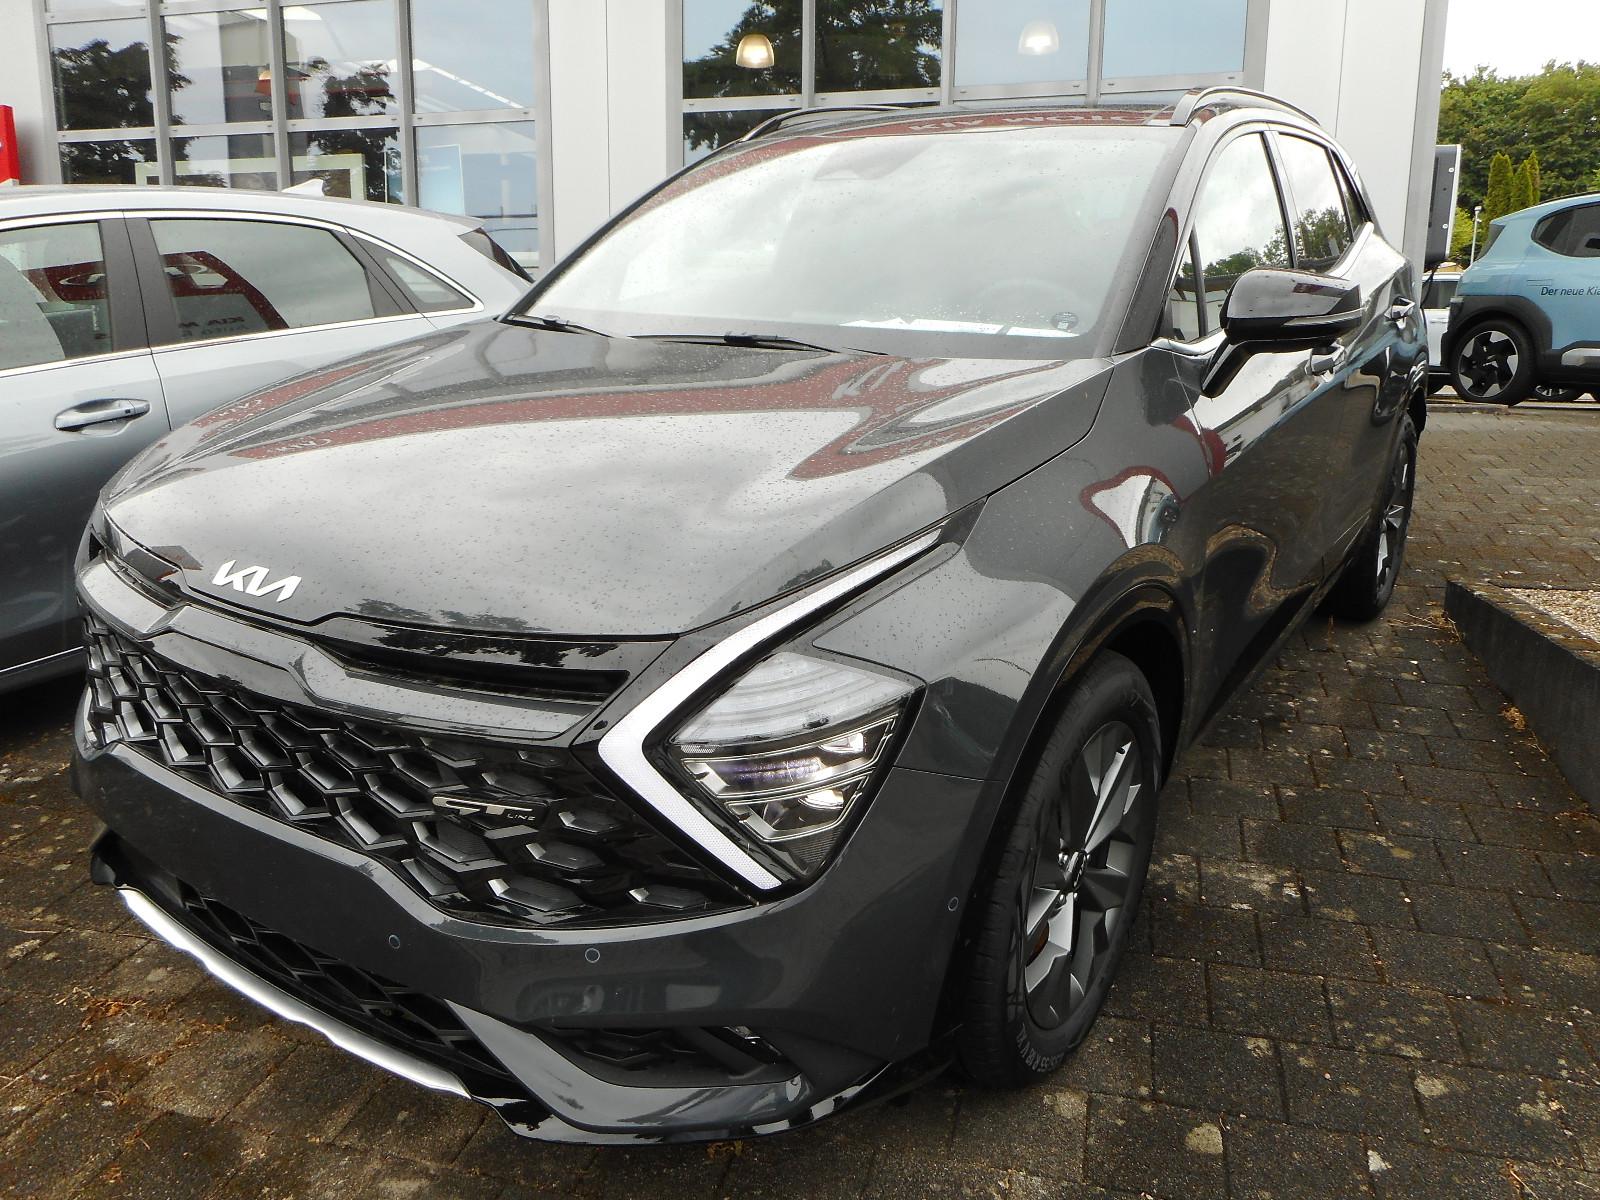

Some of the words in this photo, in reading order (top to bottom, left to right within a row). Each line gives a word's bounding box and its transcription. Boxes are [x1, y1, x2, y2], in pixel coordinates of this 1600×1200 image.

[1540, 286, 1559, 296] Der
[1560, 288, 1585, 296] neue
[212, 559, 302, 603] KIA
[506, 813, 536, 821] LINE
